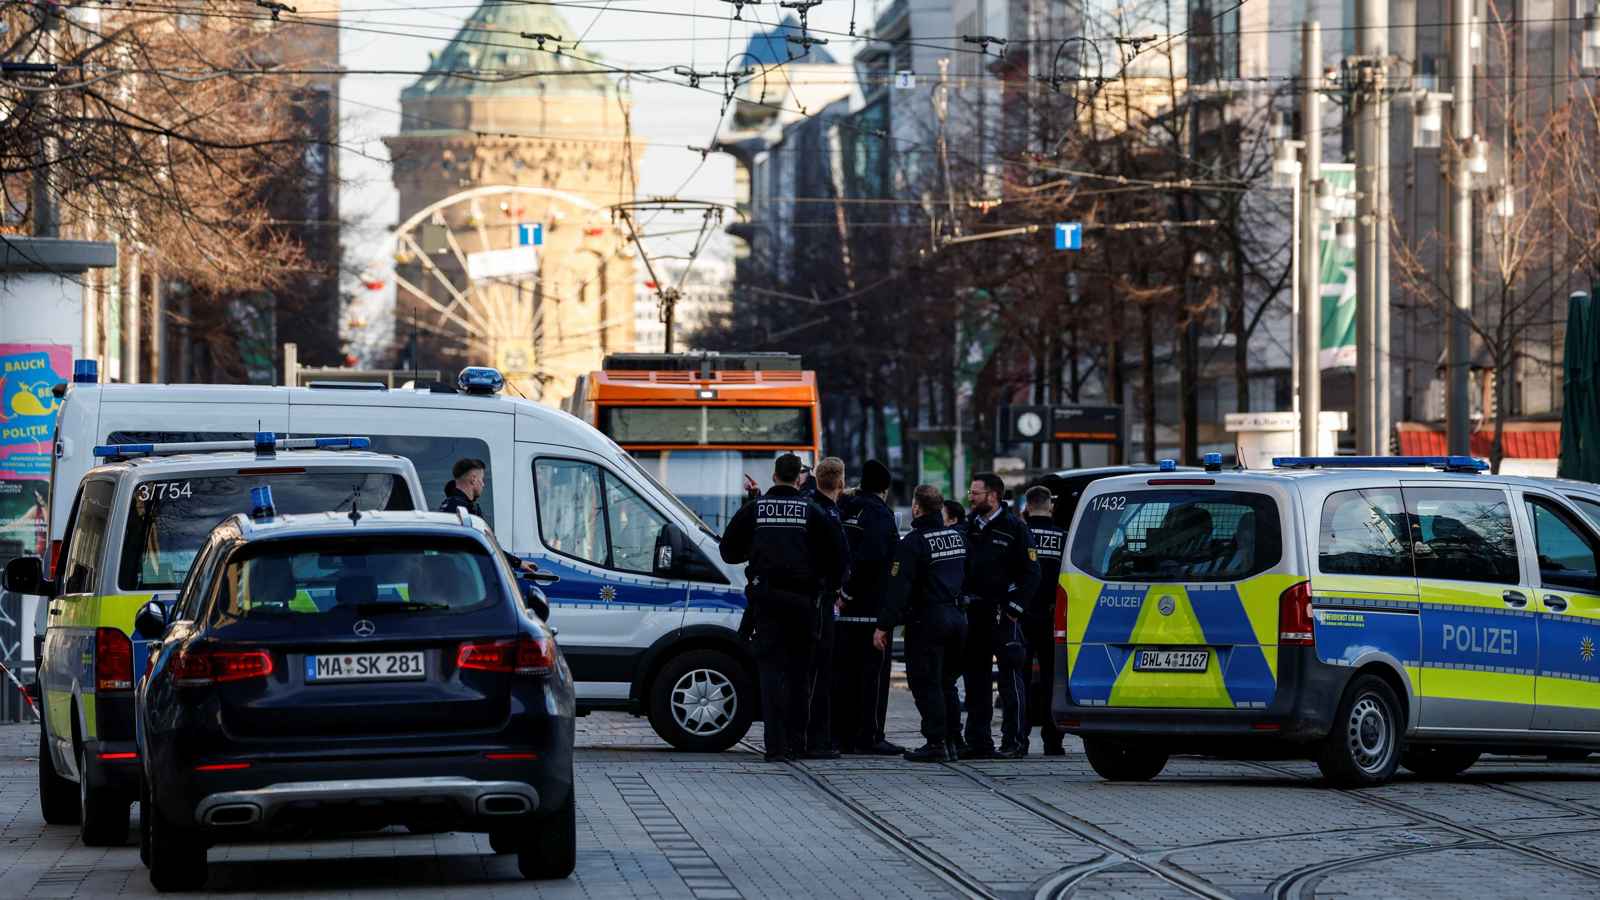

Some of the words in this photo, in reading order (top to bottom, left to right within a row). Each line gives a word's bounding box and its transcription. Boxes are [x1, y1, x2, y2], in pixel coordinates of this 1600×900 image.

[1059, 224, 1077, 248] T
[5, 359, 45, 372] BAUCH
[3, 424, 48, 439] POLITIK
[138, 481, 192, 501] 3/754
[758, 504, 806, 517] POLIZEI
[1092, 496, 1126, 511] 1/432
[929, 535, 964, 551] POLIZEI
[1039, 536, 1061, 549] IZEI
[1100, 596, 1140, 608] POLIZEI
[1442, 624, 1518, 655] POLIZEI
[317, 657, 342, 676] MA
[356, 656, 380, 674] SK
[386, 655, 422, 673] 281
[1142, 652, 1162, 667] BWL
[1165, 653, 1171, 667] 4
[1179, 653, 1206, 667] 1167
